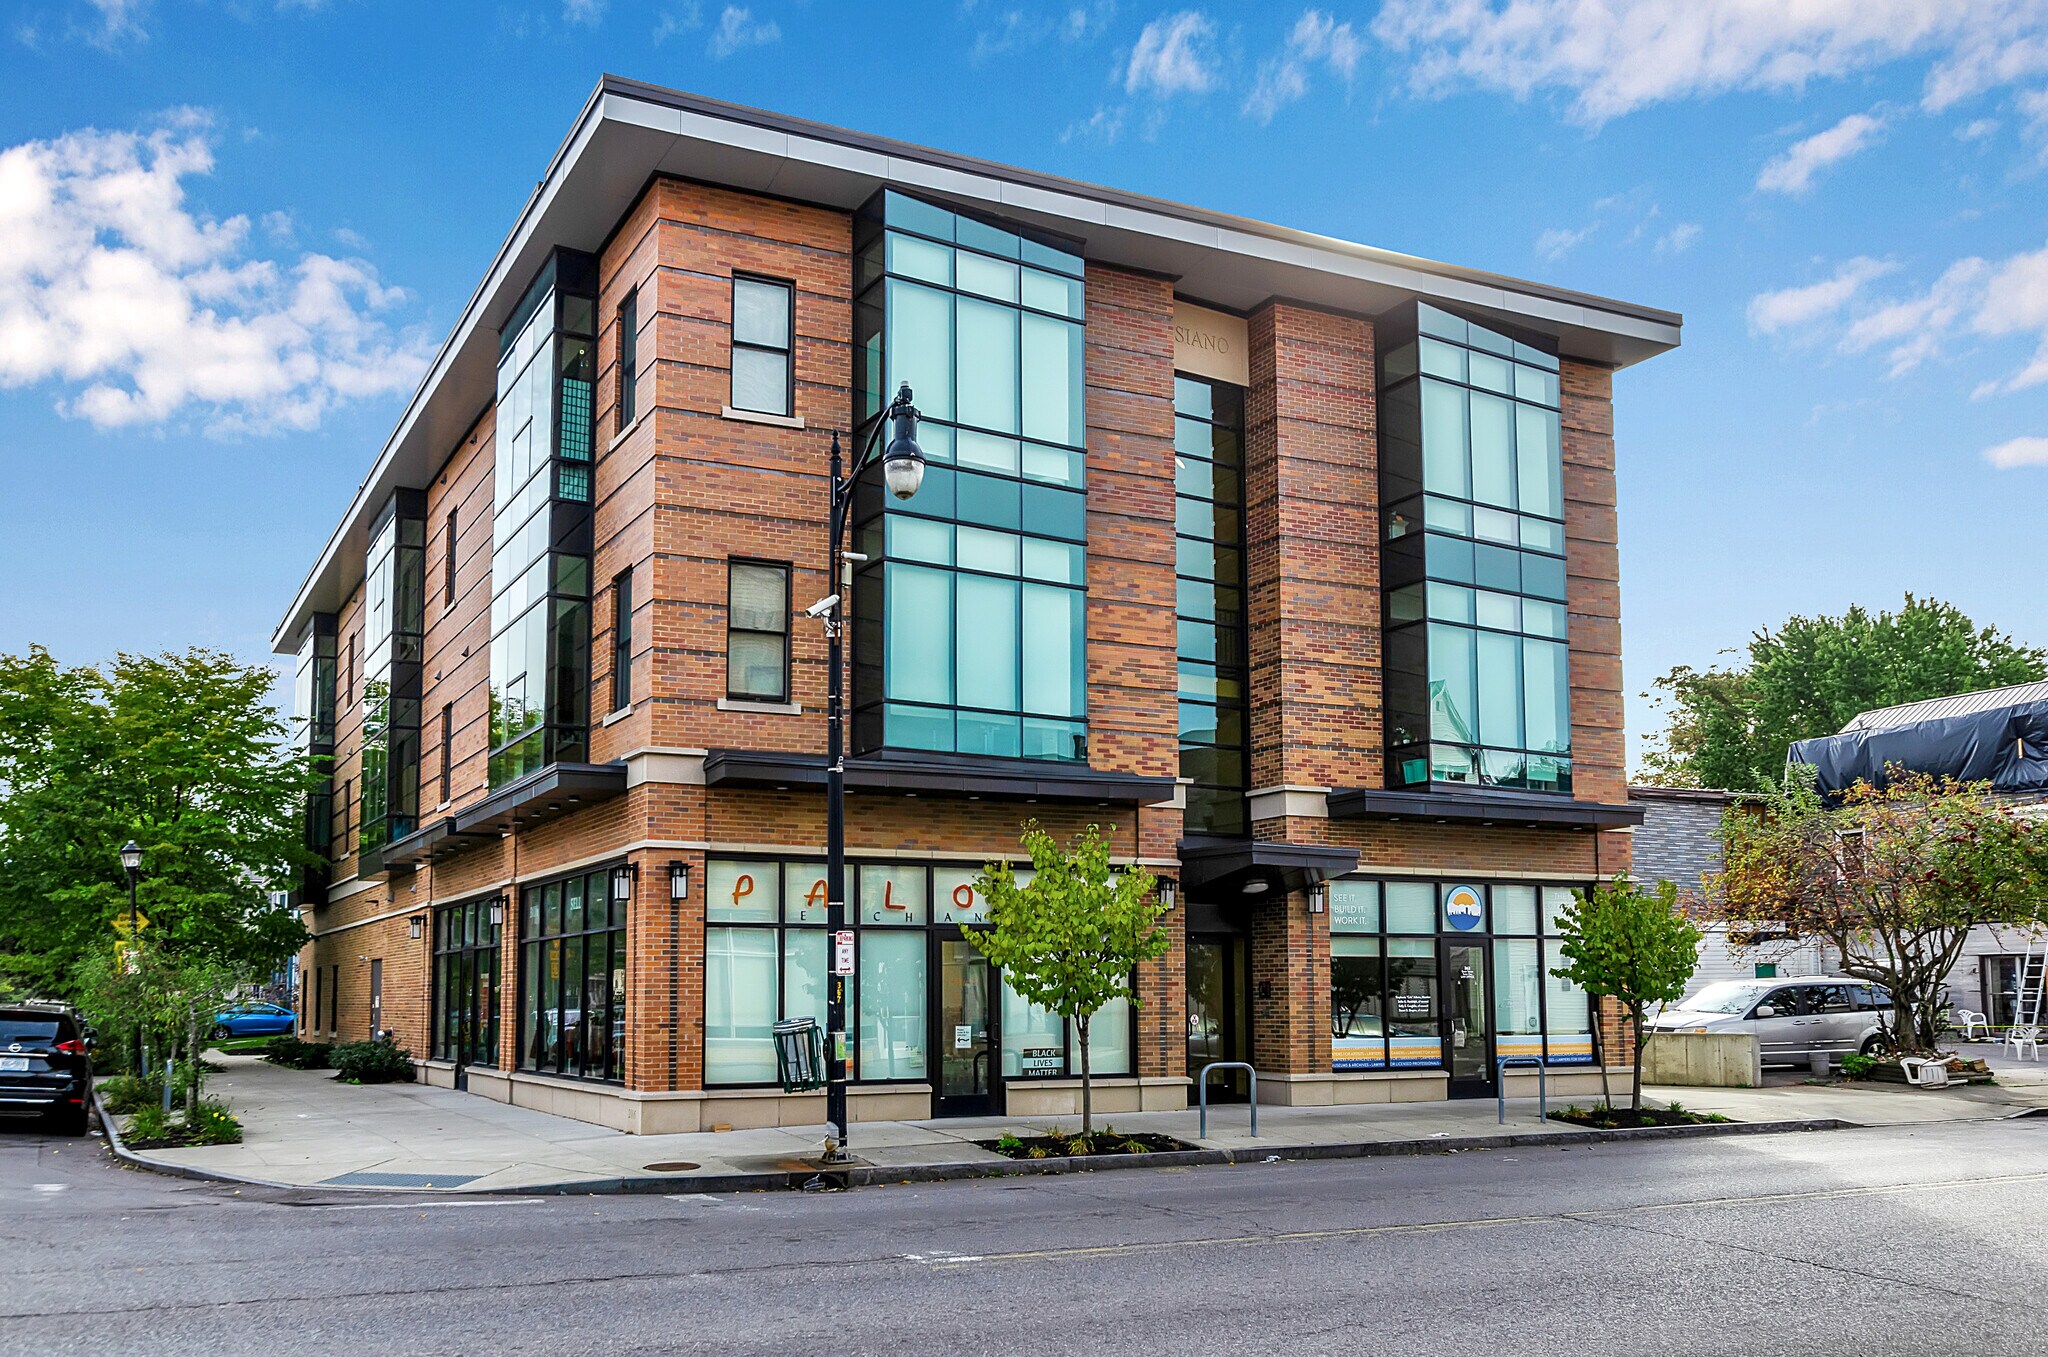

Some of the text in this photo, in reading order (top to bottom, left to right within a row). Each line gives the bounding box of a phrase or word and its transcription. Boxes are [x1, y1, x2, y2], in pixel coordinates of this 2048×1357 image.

[1175, 326, 1229, 353] SIANO
[1334, 905, 1356, 913] BUILD
[801, 911, 982, 923] ECHAN
[1334, 916, 1358, 924] WORK
[1032, 1049, 1056, 1057] BLACK
[1033, 1059, 1053, 1067] LIVES
